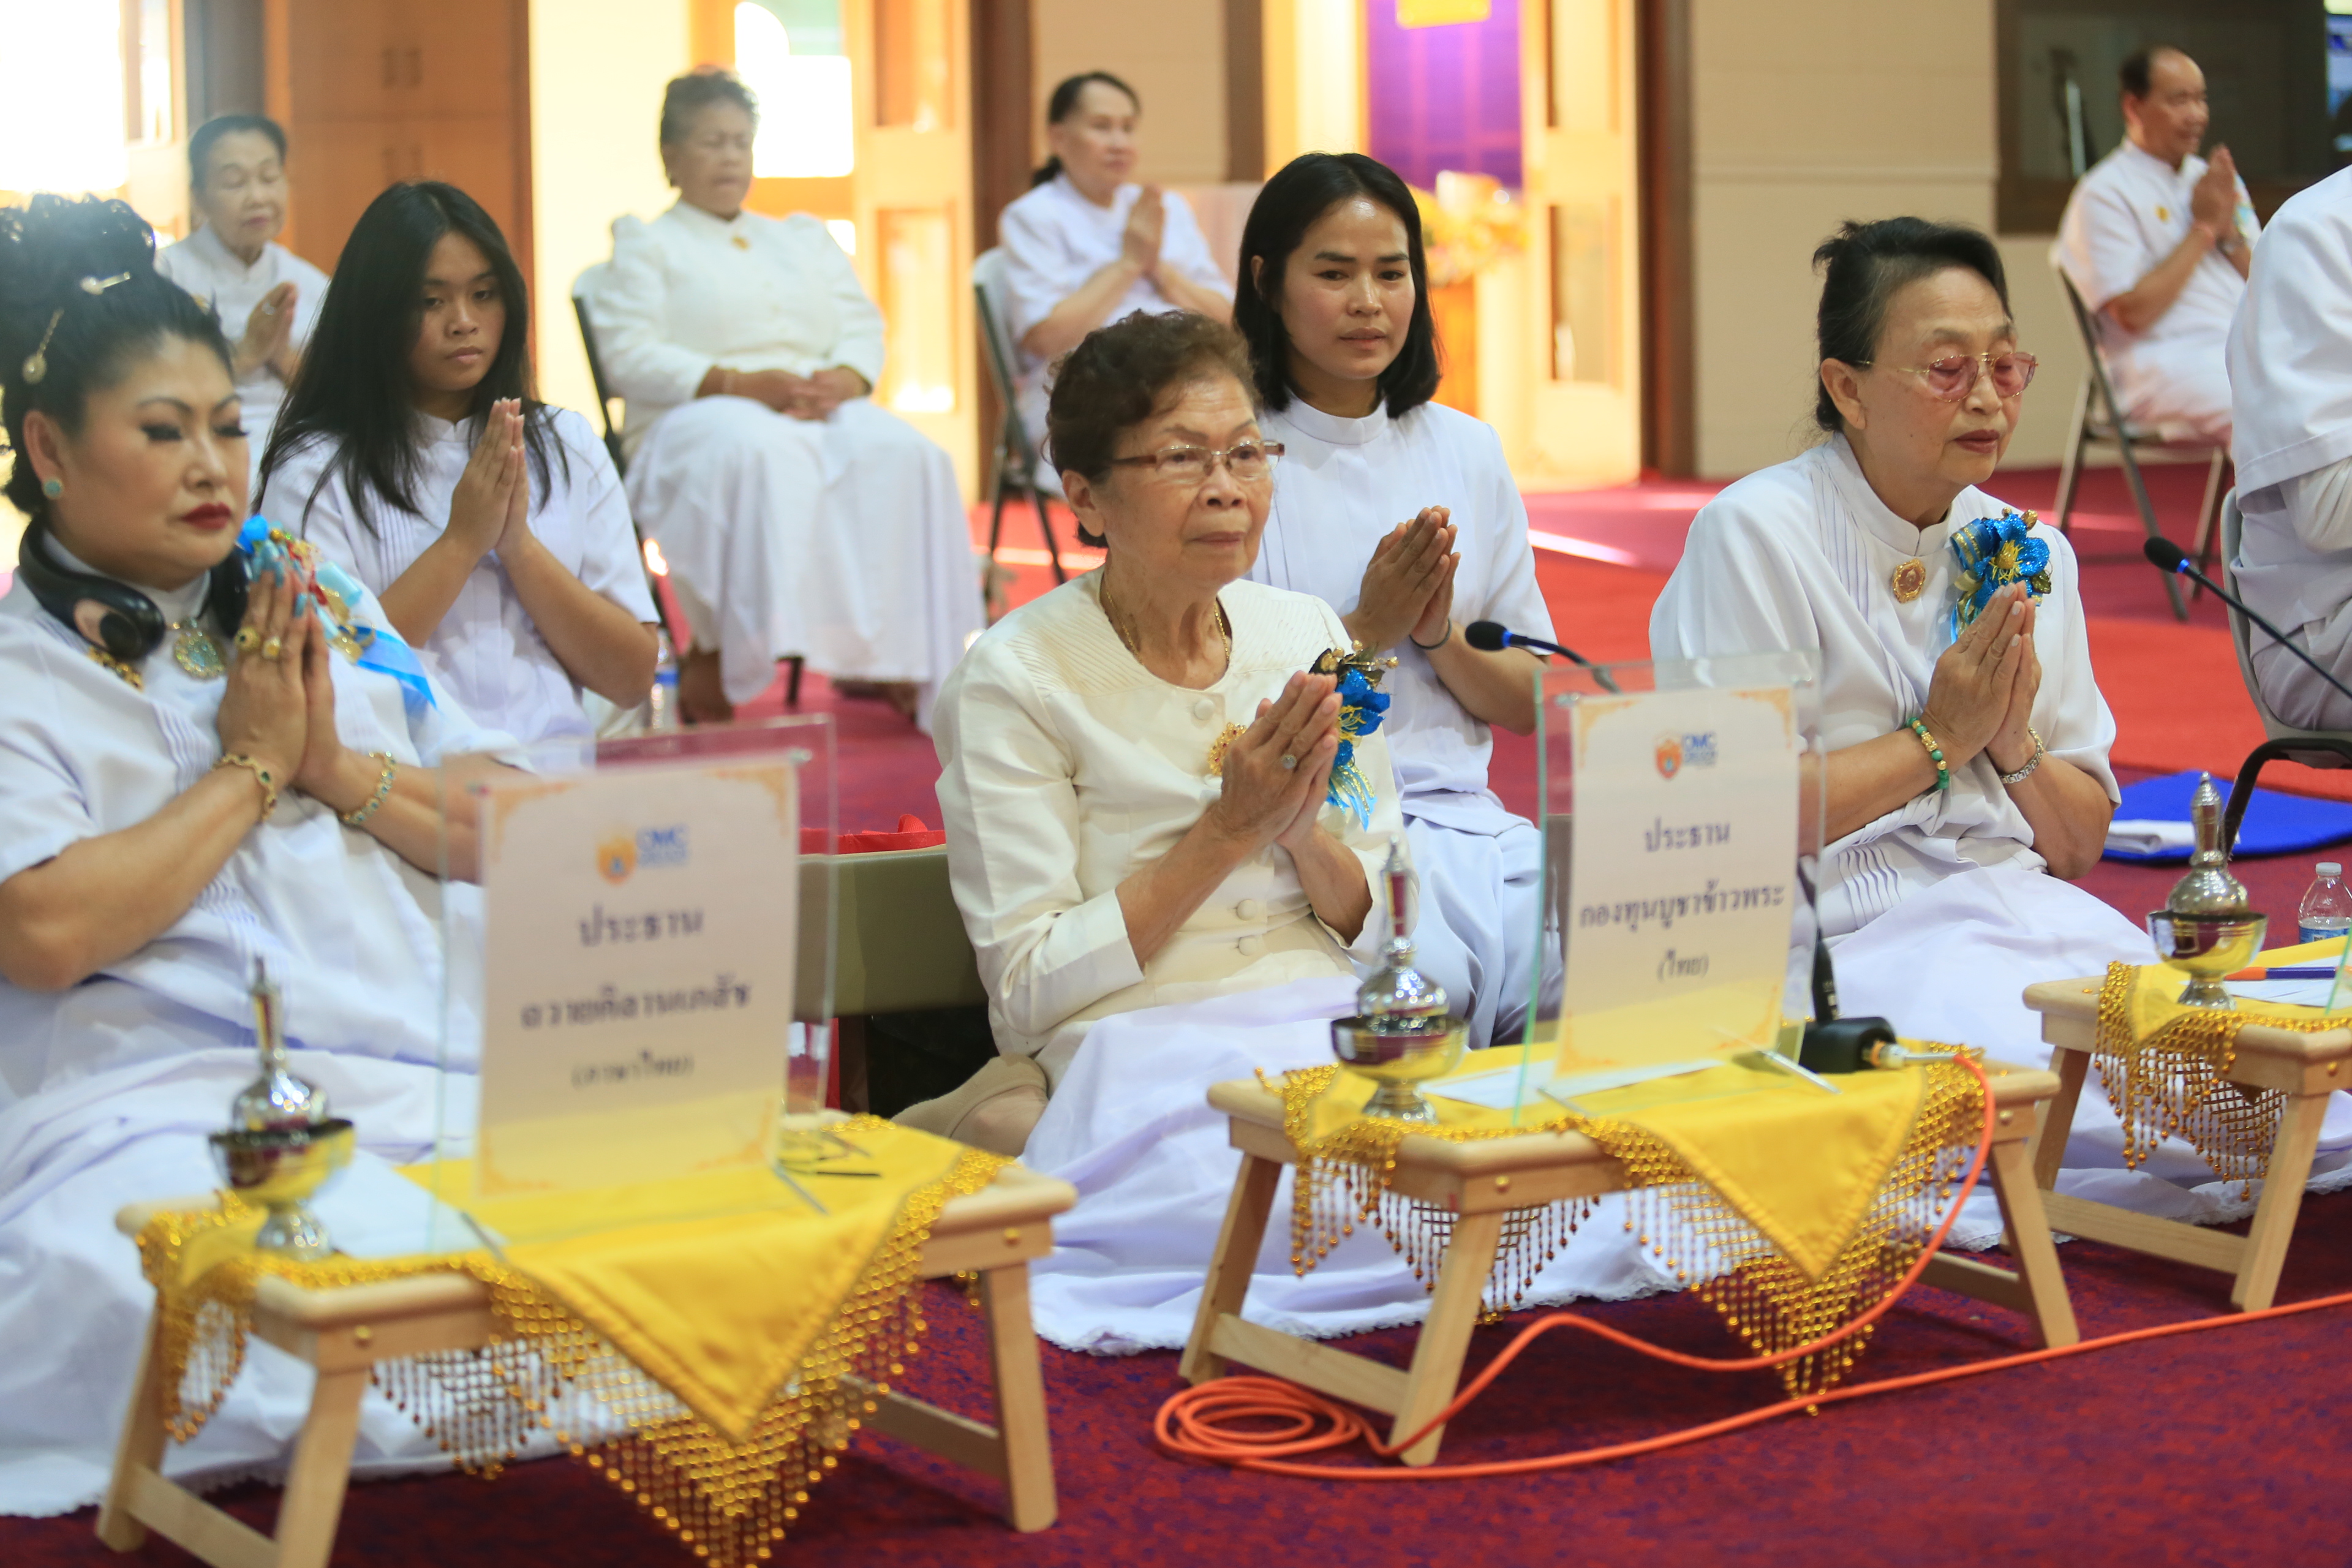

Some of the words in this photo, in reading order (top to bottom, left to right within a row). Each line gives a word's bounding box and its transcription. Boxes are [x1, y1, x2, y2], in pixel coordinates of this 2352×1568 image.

[1644, 816, 1730, 853] ประธาน
[578, 901, 704, 948] ประธาน
[1578, 878, 1786, 933] กองทุนบูชาข้าวพระ
[1656, 948, 1710, 983] (ไทย)
